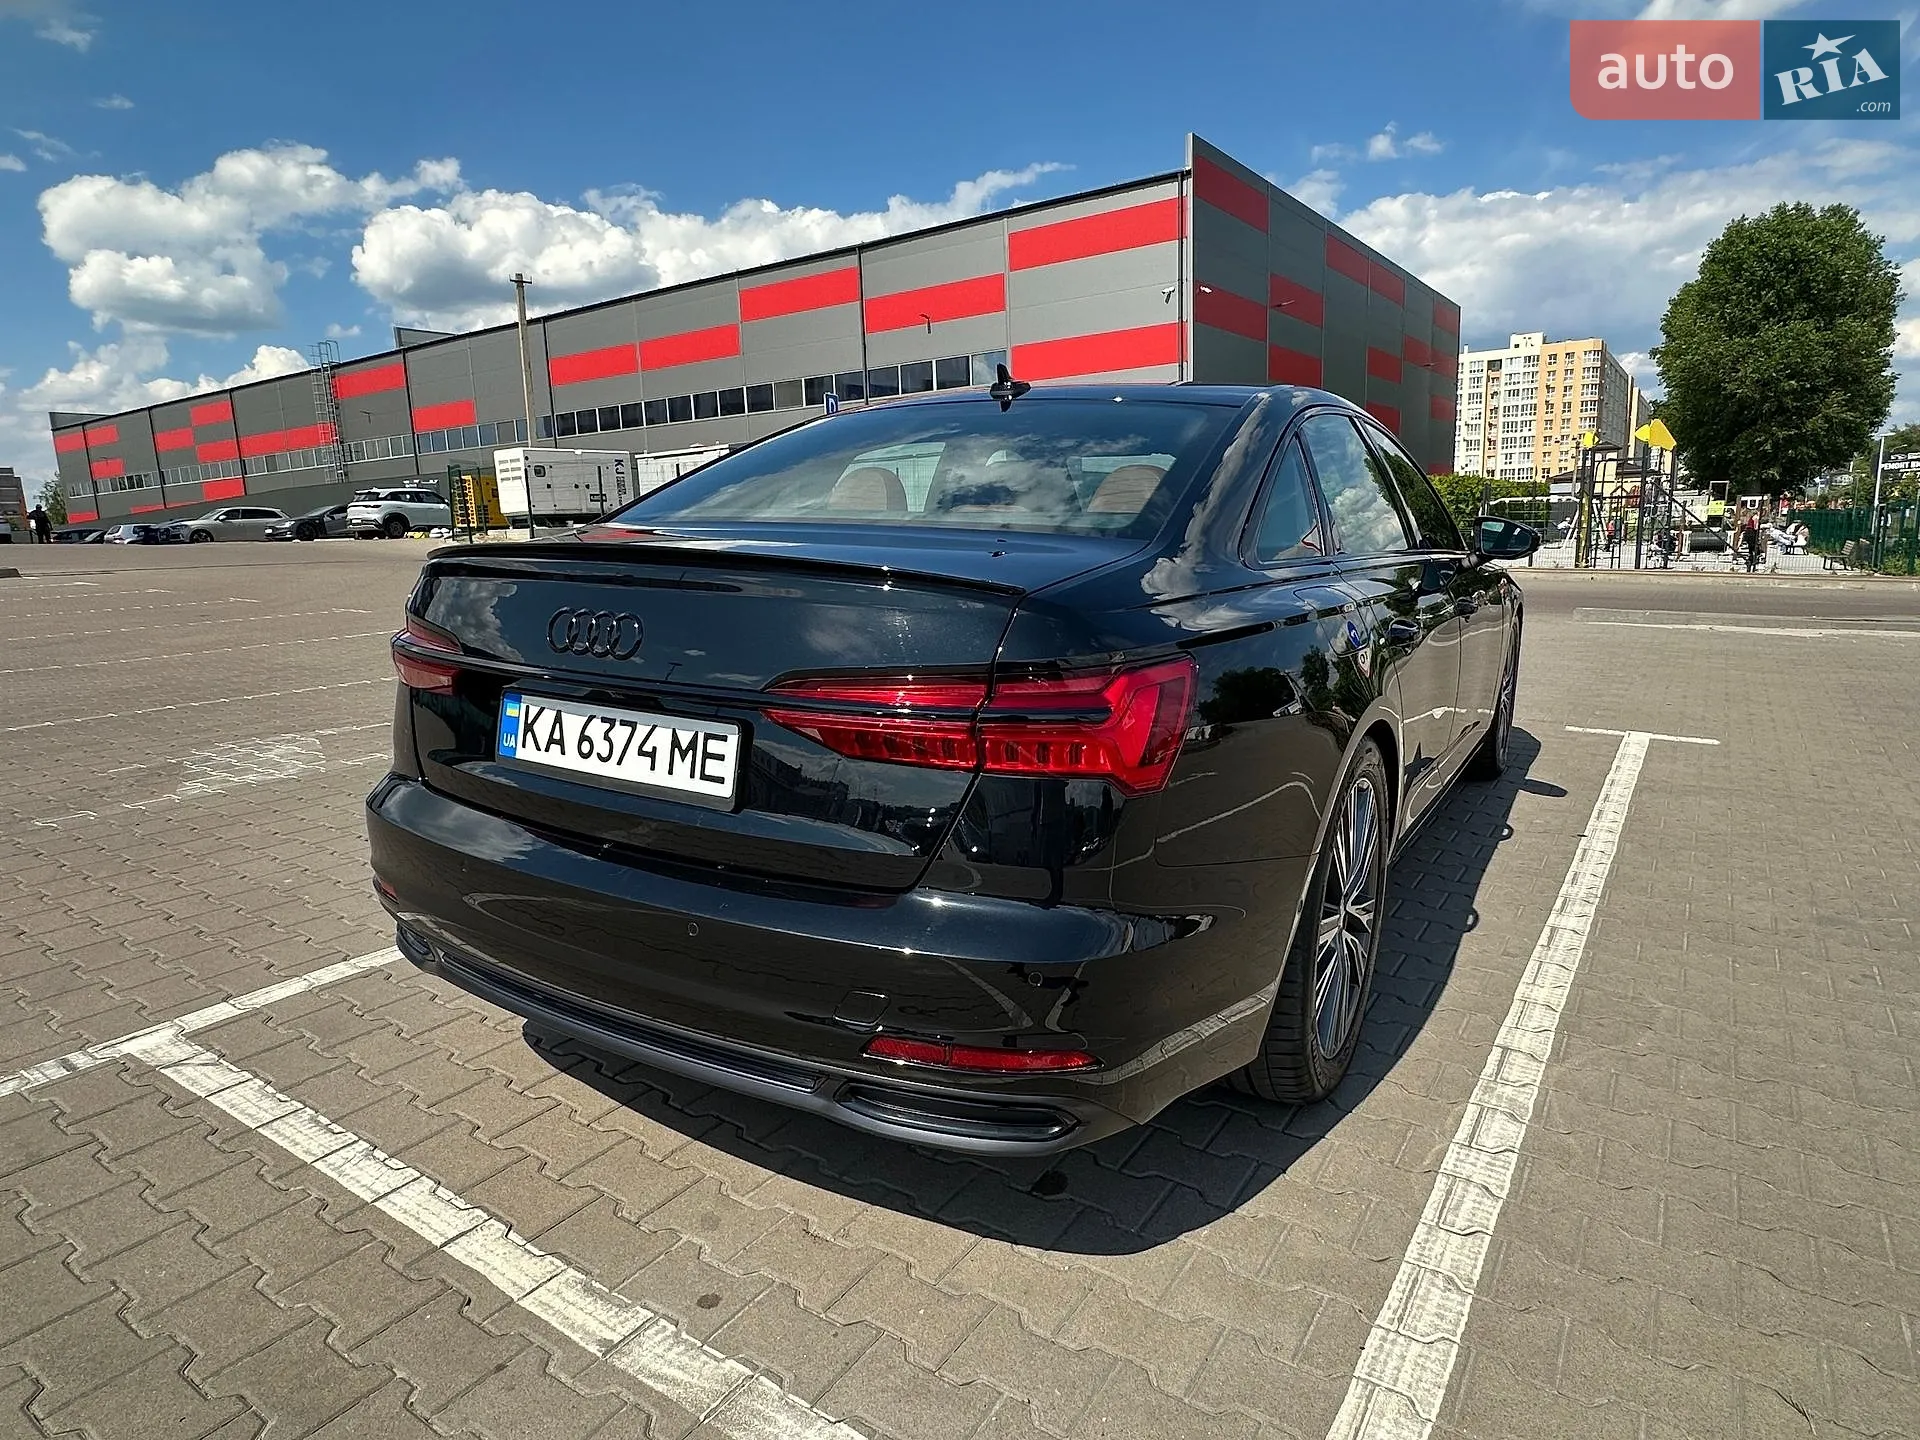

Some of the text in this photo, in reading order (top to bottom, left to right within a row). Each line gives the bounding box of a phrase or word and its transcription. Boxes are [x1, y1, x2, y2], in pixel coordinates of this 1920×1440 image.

[503, 732, 516, 749] UA
[521, 704, 728, 785] KA 6374 ME
